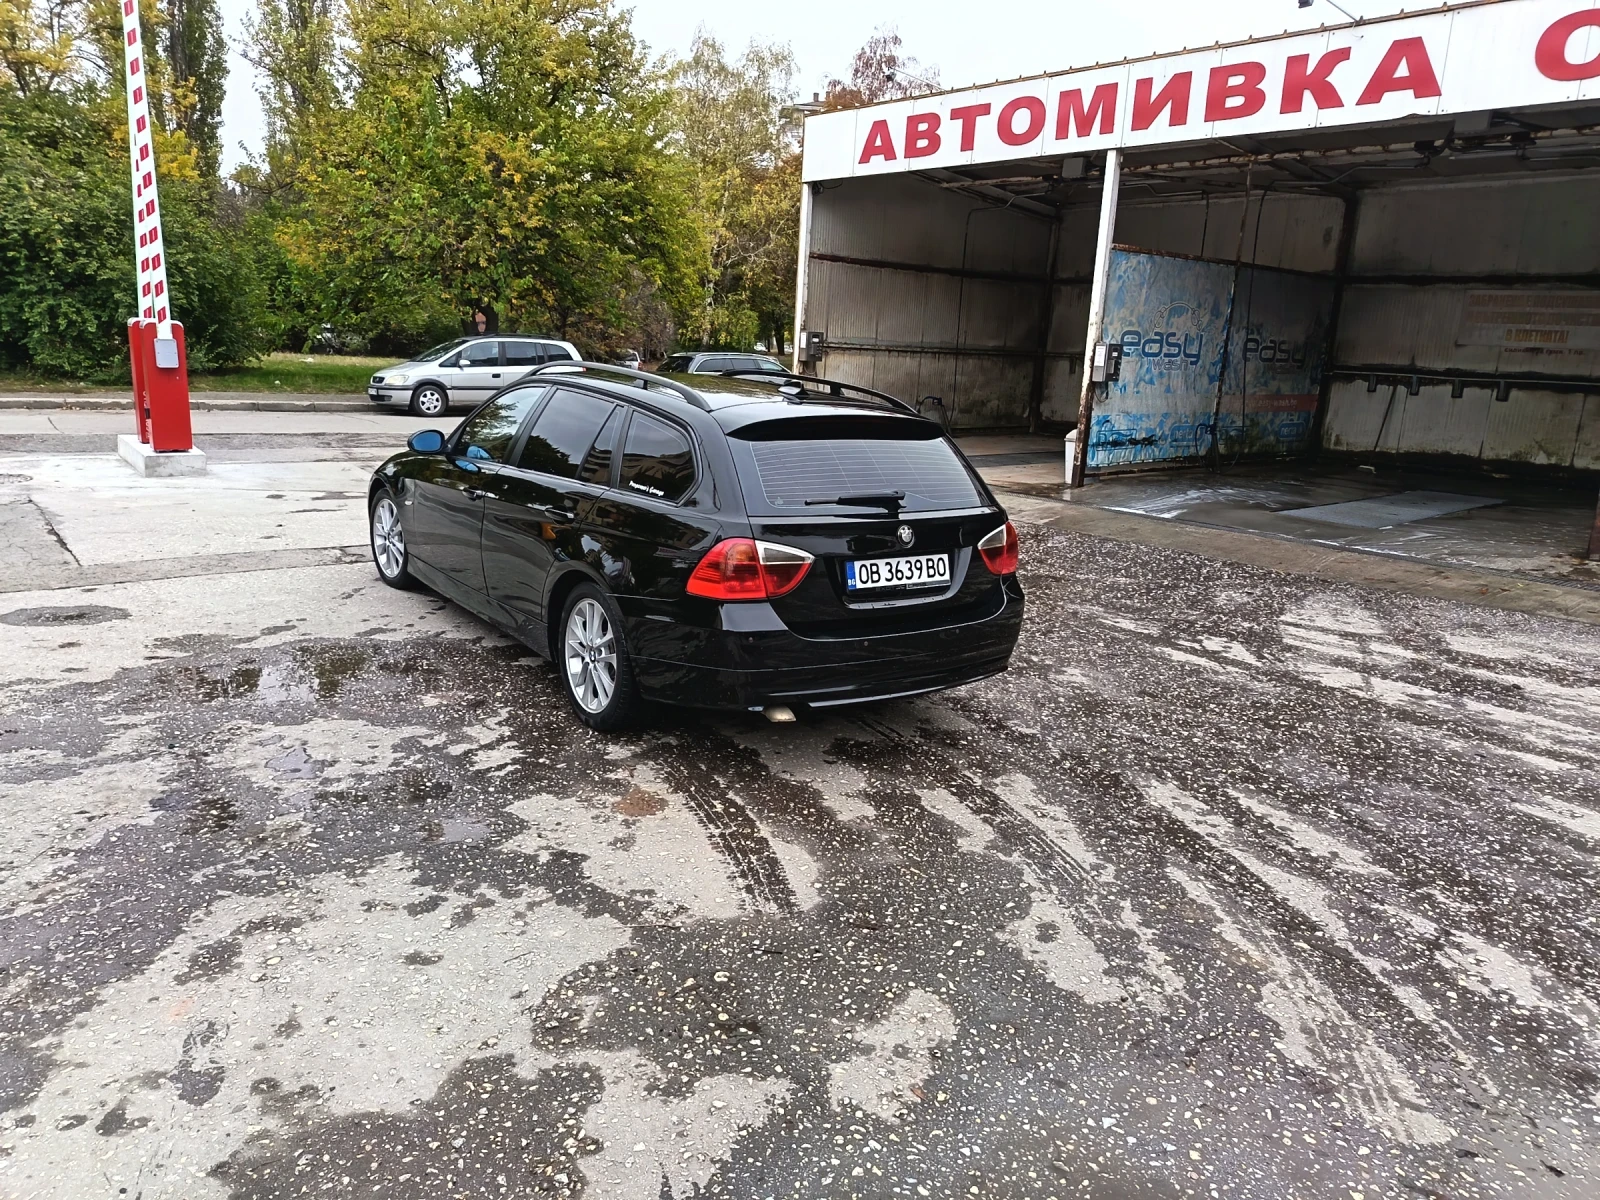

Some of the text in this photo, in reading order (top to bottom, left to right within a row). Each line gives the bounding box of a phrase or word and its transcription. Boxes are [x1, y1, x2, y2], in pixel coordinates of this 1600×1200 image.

[858, 36, 1442, 164] АВТОМИВКА
[1120, 329, 1203, 366] easy
[1505, 329, 1513, 342] В
[1152, 358, 1189, 371] wash
[1242, 336, 1307, 367] easy
